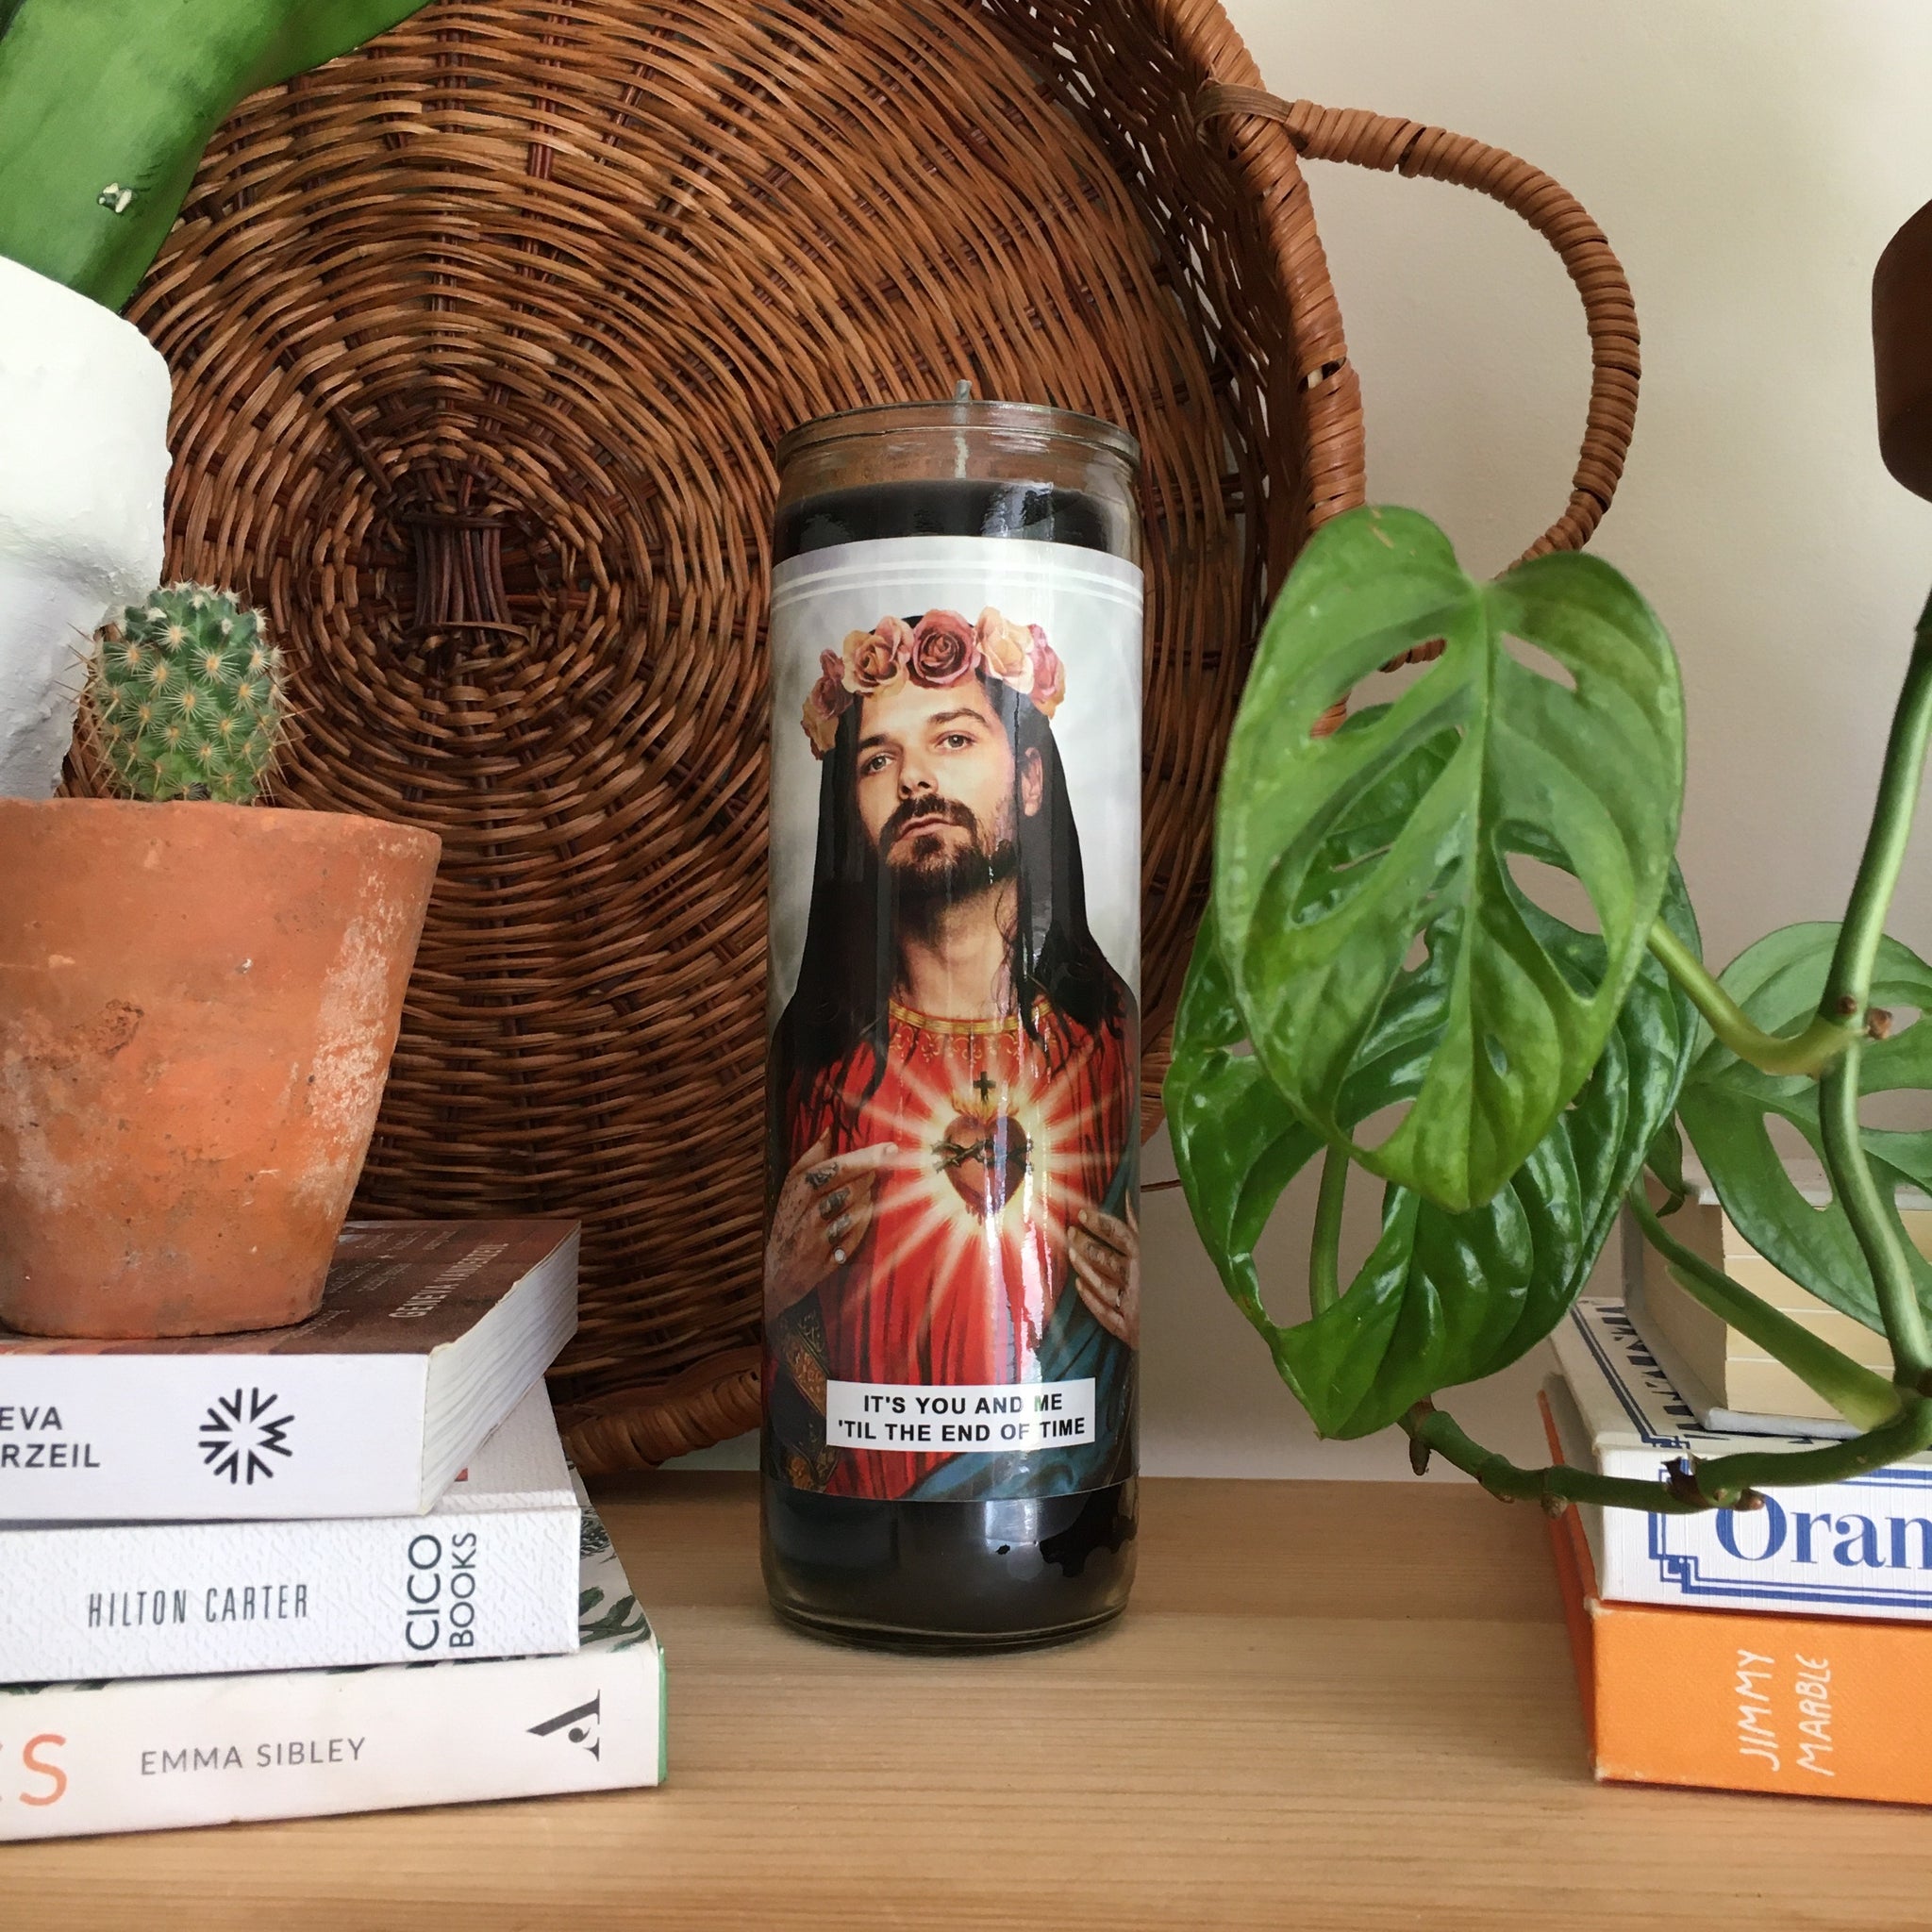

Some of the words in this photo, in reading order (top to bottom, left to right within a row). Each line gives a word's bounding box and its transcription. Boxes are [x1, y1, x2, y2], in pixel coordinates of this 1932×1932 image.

[388, 1283, 459, 1318] GENEVA
[0, 1406, 63, 1431] EVA
[838, 1419, 877, 1441] 'TIL
[884, 1423, 932, 1442] THE
[941, 1424, 991, 1442] END
[1000, 1423, 1031, 1441] OF
[1040, 1416, 1086, 1439] TIME
[862, 1394, 906, 1414] IT'S
[915, 1396, 966, 1415] YOU
[974, 1396, 1024, 1414] AND
[1034, 1392, 1063, 1412] ME
[1, 1442, 101, 1469] RZEIL
[1715, 1492, 1932, 1570] Oran
[89, 1591, 187, 1627] HILTON
[206, 1584, 308, 1623] CARTER
[406, 1534, 442, 1651] CICO
[449, 1532, 477, 1648] BOOKS
[1736, 1649, 1780, 1772] JIMMY
[1795, 1653, 1835, 1777] MARBLE
[0, 1733, 68, 1807] S
[141, 1746, 243, 1775] EMMA
[257, 1737, 366, 1768] SIBLEY
